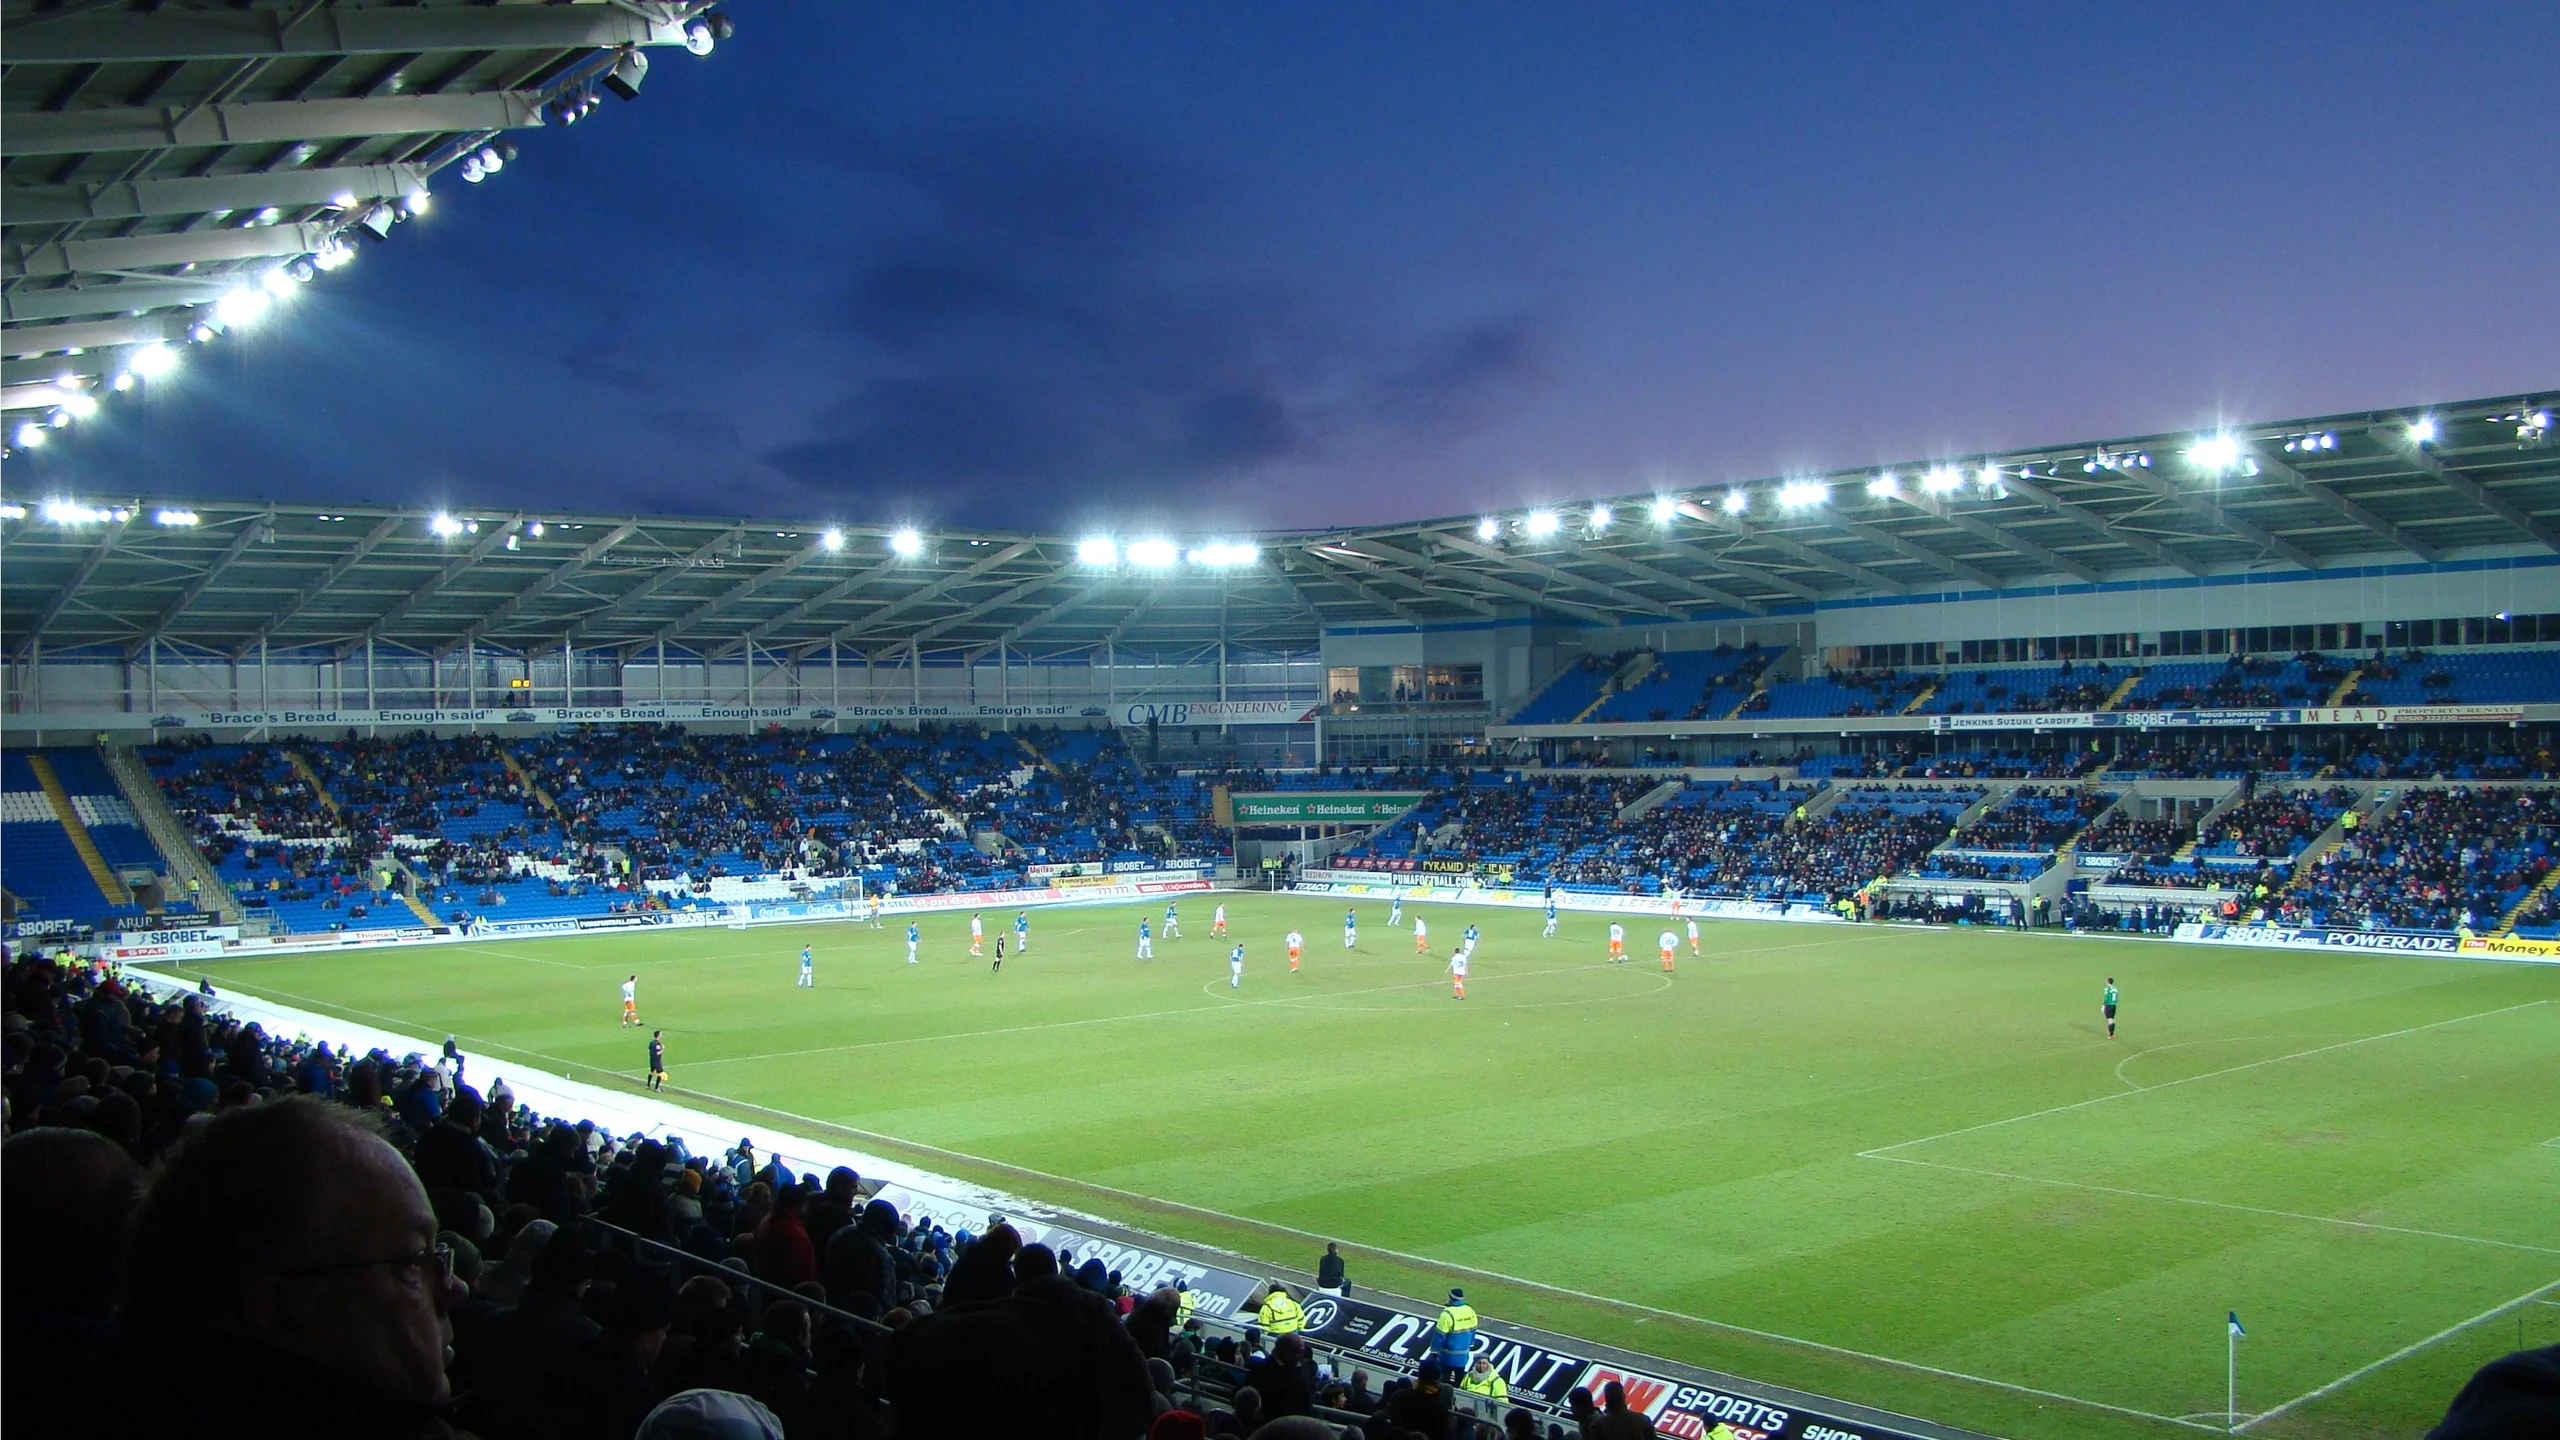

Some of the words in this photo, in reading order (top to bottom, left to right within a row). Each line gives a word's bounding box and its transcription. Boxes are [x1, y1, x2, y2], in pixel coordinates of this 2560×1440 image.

[1128, 703, 1188, 724] CMB
[1189, 701, 1288, 714] ENGINEERING
[1953, 718, 1993, 727] JENKINS
[1996, 717, 2032, 726] SUZUKI
[2035, 717, 2079, 725] CARDIFF
[2125, 713, 2188, 726] SBOBET.com
[1249, 804, 1300, 815] Heineken
[1316, 804, 1365, 814] Heineken
[1113, 861, 1155, 872] SBOBET.com
[1165, 859, 1213, 869] SBOBET.com
[1423, 860, 1463, 872] PYRAMID
[1305, 871, 1333, 880] REDROW
[1294, 883, 1330, 892] TEXACO
[117, 916, 153, 930] ARUP
[2222, 926, 2319, 945] SBOBET.com
[128, 947, 169, 957] SPAR
[2463, 939, 2485, 948] The
[2486, 942, 2549, 957] Money
[907, 1200, 986, 1235] Pro-Cop
[1672, 1386, 1789, 1432] SPORTS
